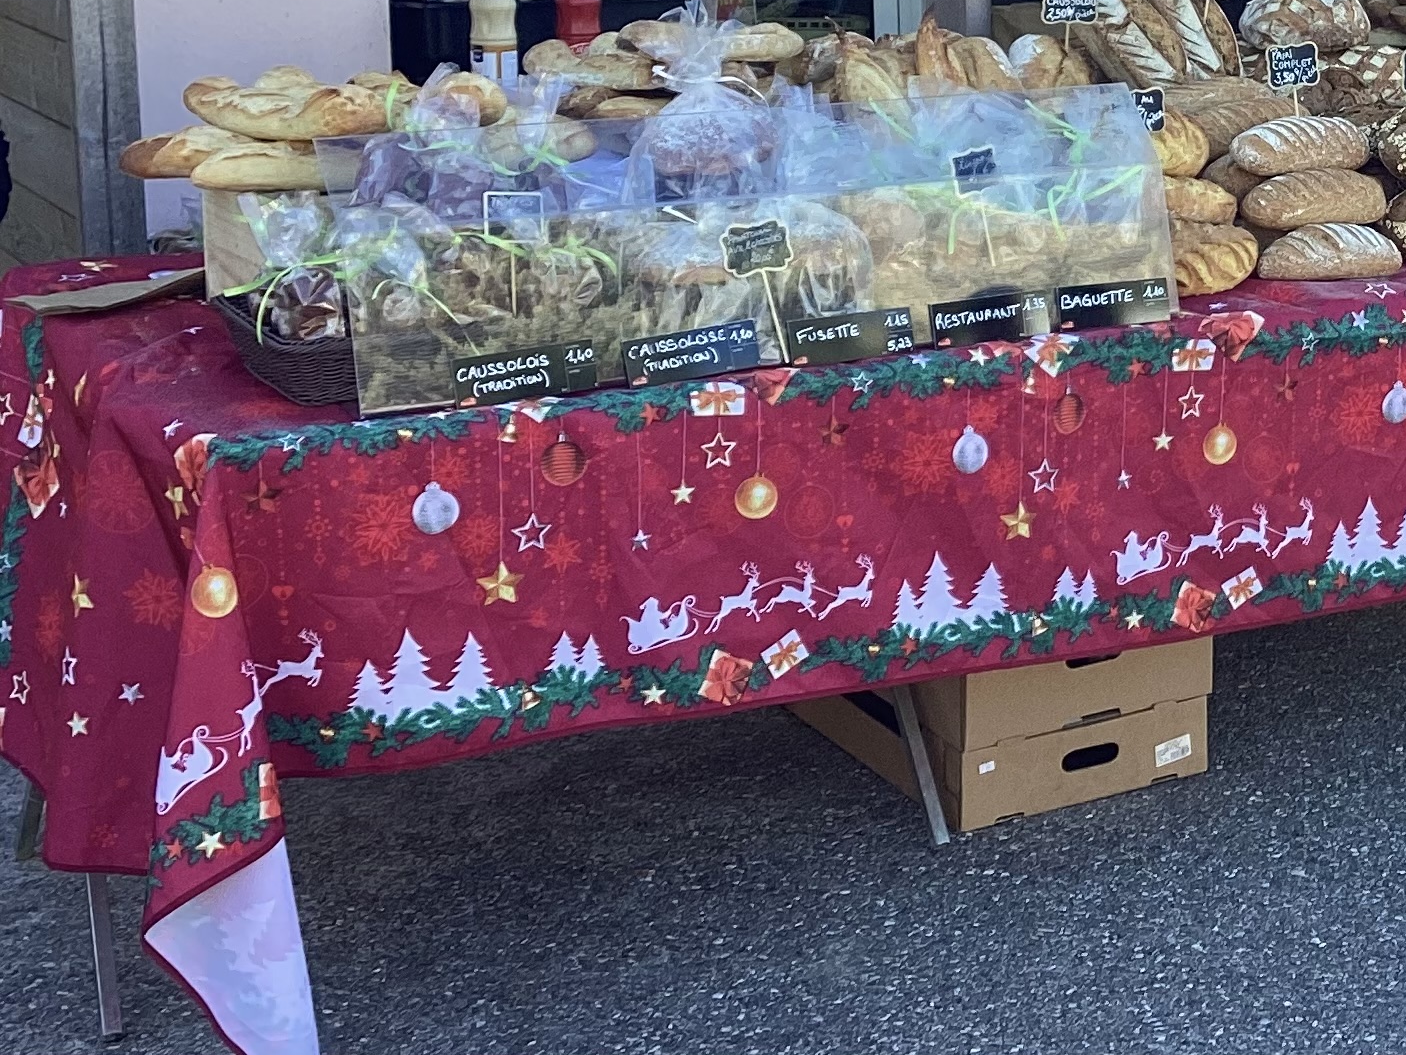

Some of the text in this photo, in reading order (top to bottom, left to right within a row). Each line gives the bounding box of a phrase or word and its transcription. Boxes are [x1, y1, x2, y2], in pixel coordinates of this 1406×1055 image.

[1060, 289, 1134, 310] BAGUETTE
[934, 304, 1021, 331] RESTAURANT
[795, 322, 860, 345] FUSETTE
